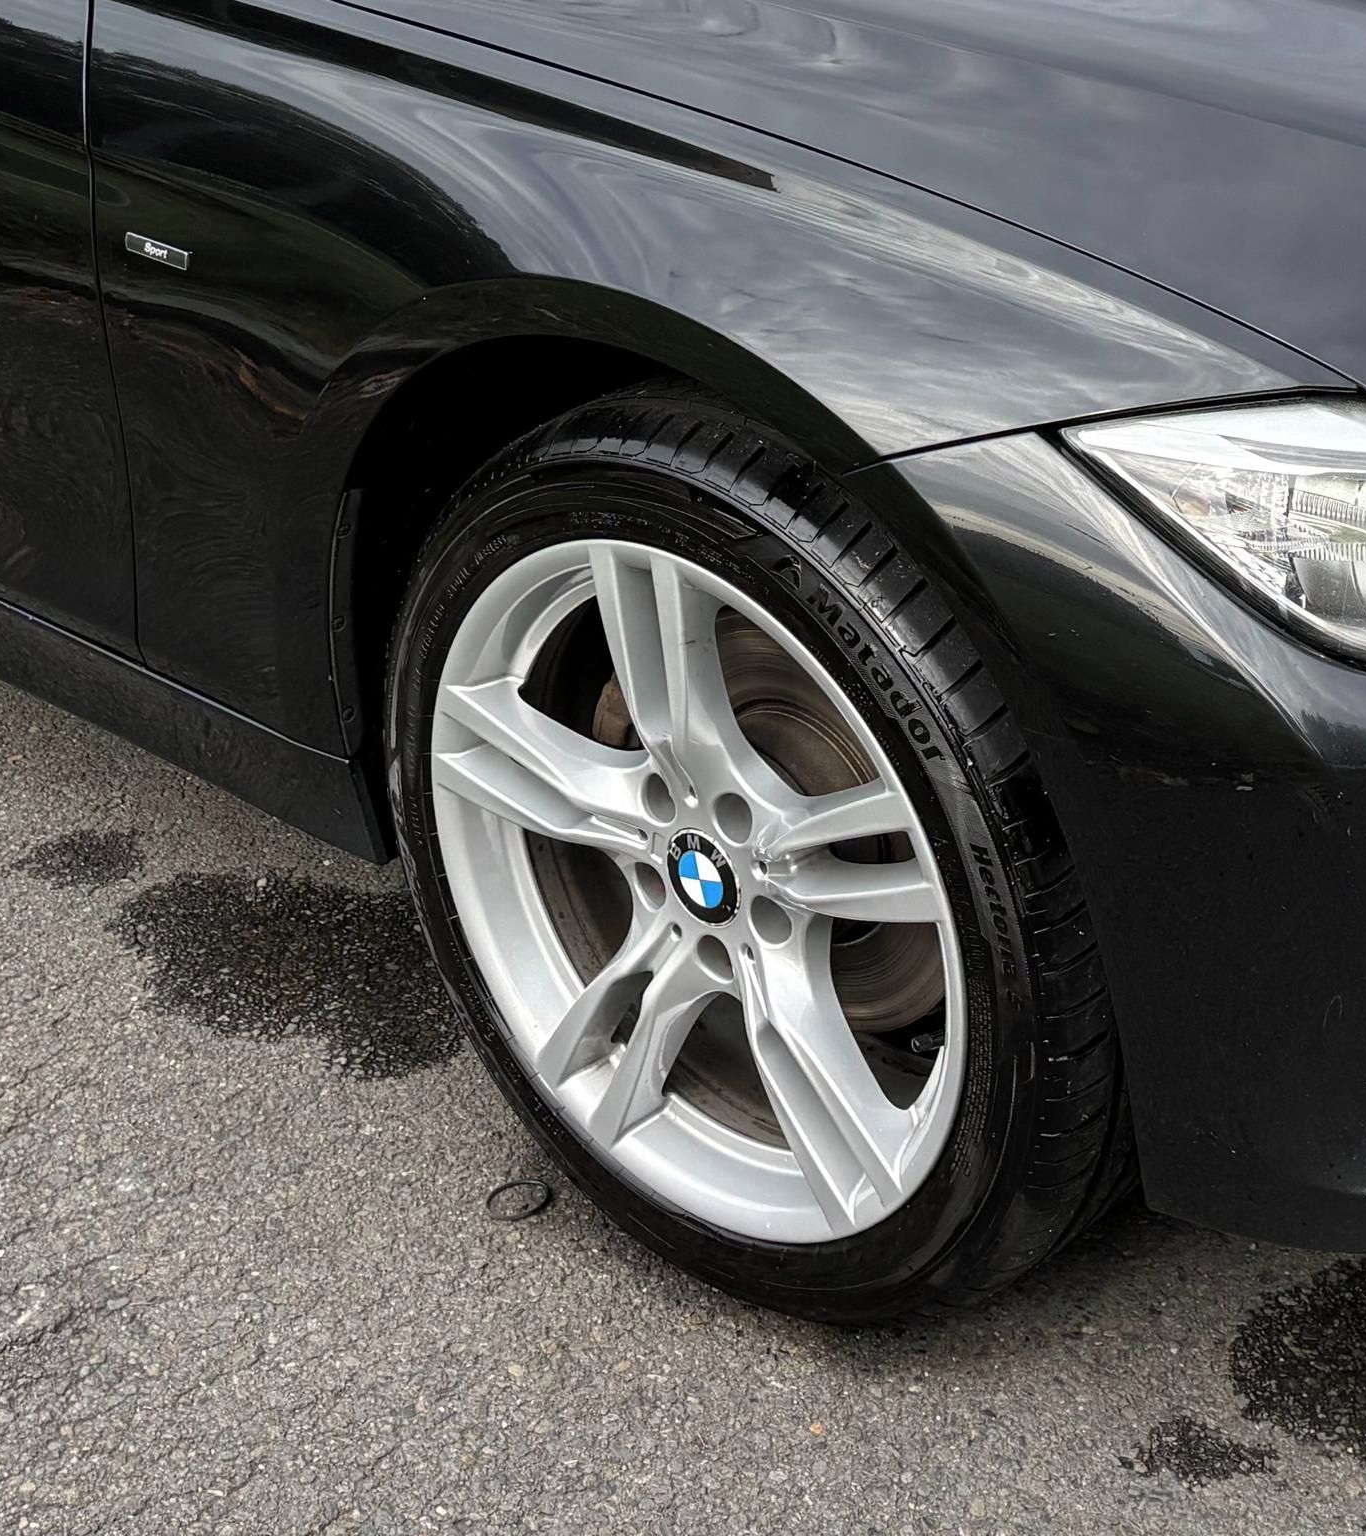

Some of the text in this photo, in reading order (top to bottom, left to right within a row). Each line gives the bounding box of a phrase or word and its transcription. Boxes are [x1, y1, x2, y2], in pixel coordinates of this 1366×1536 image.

[144, 242, 169, 260] Sport
[806, 582, 946, 762] Matador
[669, 833, 727, 868] BMW
